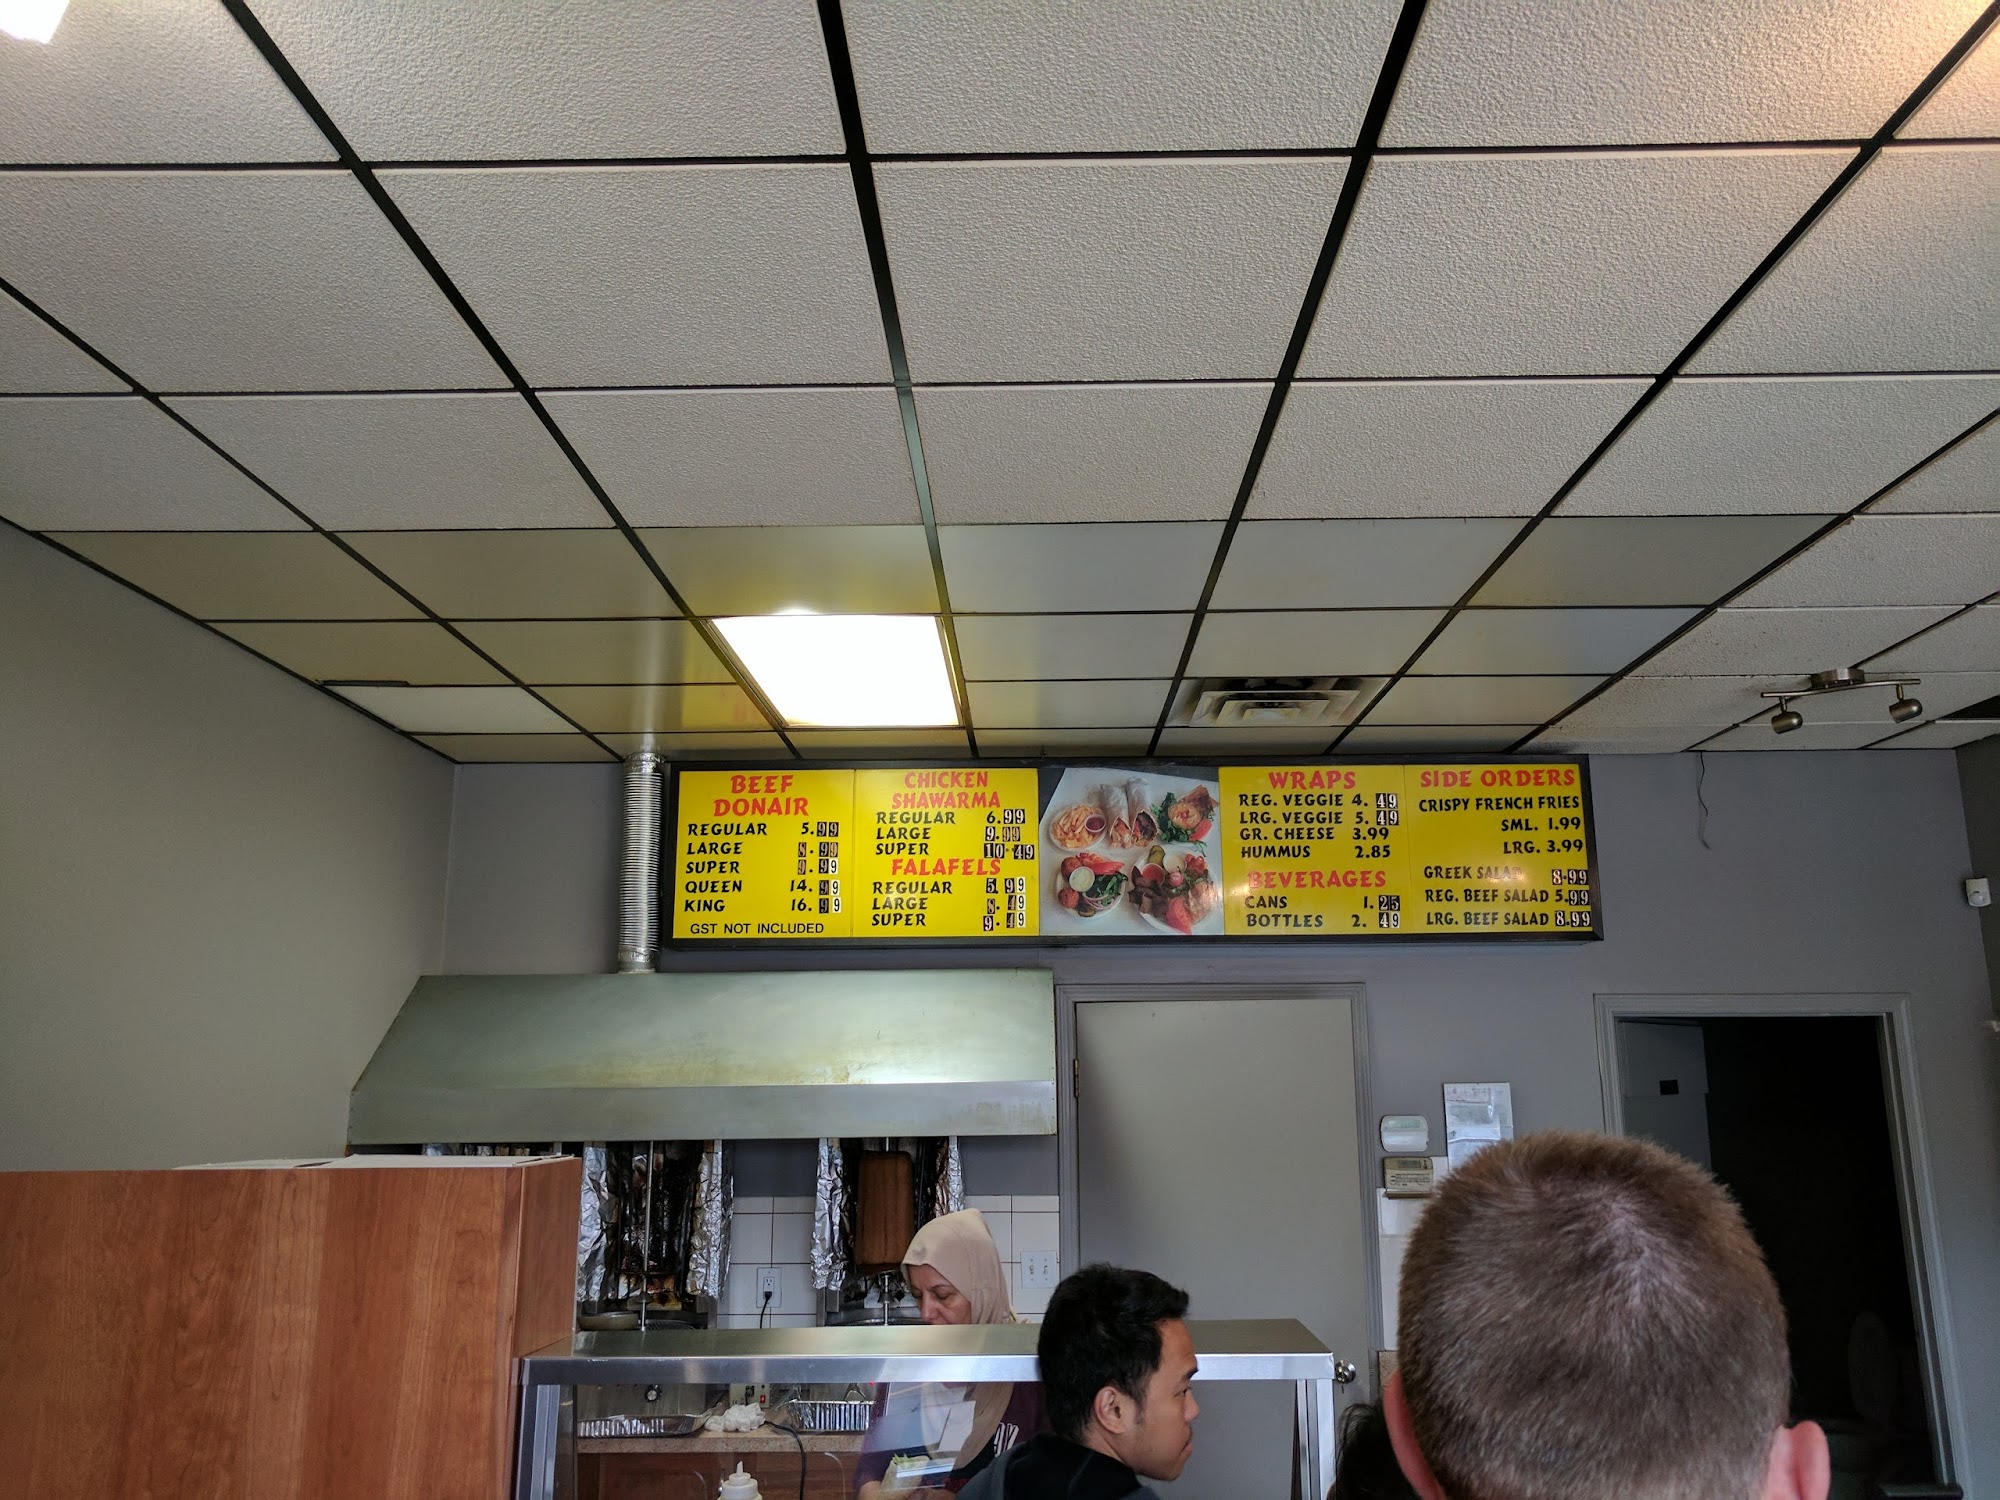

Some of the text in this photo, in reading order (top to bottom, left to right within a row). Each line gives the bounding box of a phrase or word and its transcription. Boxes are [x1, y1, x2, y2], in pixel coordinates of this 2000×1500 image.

[731, 775, 793, 793] BEEF
[905, 771, 988, 788] CHICKEN
[1268, 771, 1356, 790] WRAPS
[1421, 769, 1575, 787] SIDE ORDERS
[714, 798, 809, 816] DONAIR
[892, 791, 1000, 809] SHAWARMA
[1239, 794, 1277, 806] REG.
[1283, 794, 1343, 806] VEGGIE
[1419, 796, 1579, 812] CRISPY FRENCH FRIES
[876, 809, 1025, 824] REGULAR 6.99
[1240, 812, 1277, 824] LRG.
[1282, 812, 1342, 824] VEGGIE
[688, 822, 839, 837] REGULAR 5.99
[1502, 817, 1580, 831] SML. 1.99
[876, 826, 1020, 841] LARGE 9.99
[1240, 828, 1389, 840] GR. CHEESE 3.99
[687, 842, 742, 854] LARGE
[875, 843, 929, 855] SUPER
[1241, 845, 1391, 858] HUMMUS 2.85
[1504, 839, 1583, 854] LRG. 3.99
[686, 861, 740, 873] SUPER
[892, 858, 1000, 875] FALAFELS
[1248, 870, 1386, 889] BEVERAGES
[1424, 866, 1588, 885] GREEK SALAD 8.99
[685, 880, 742, 893] QUEEN
[873, 882, 952, 894] REGULAR
[872, 898, 928, 910] LARGE
[1245, 896, 1287, 908] CANS
[1425, 889, 1589, 906] REG. BEEF SALAD 5.99
[684, 900, 725, 912] KING
[872, 913, 926, 926] SUPER
[1246, 914, 1323, 927] BOTTLES
[1427, 911, 1591, 927] LRG. BEEF SALAD 8.99
[690, 924, 823, 933] GST NOT INCLUDED
